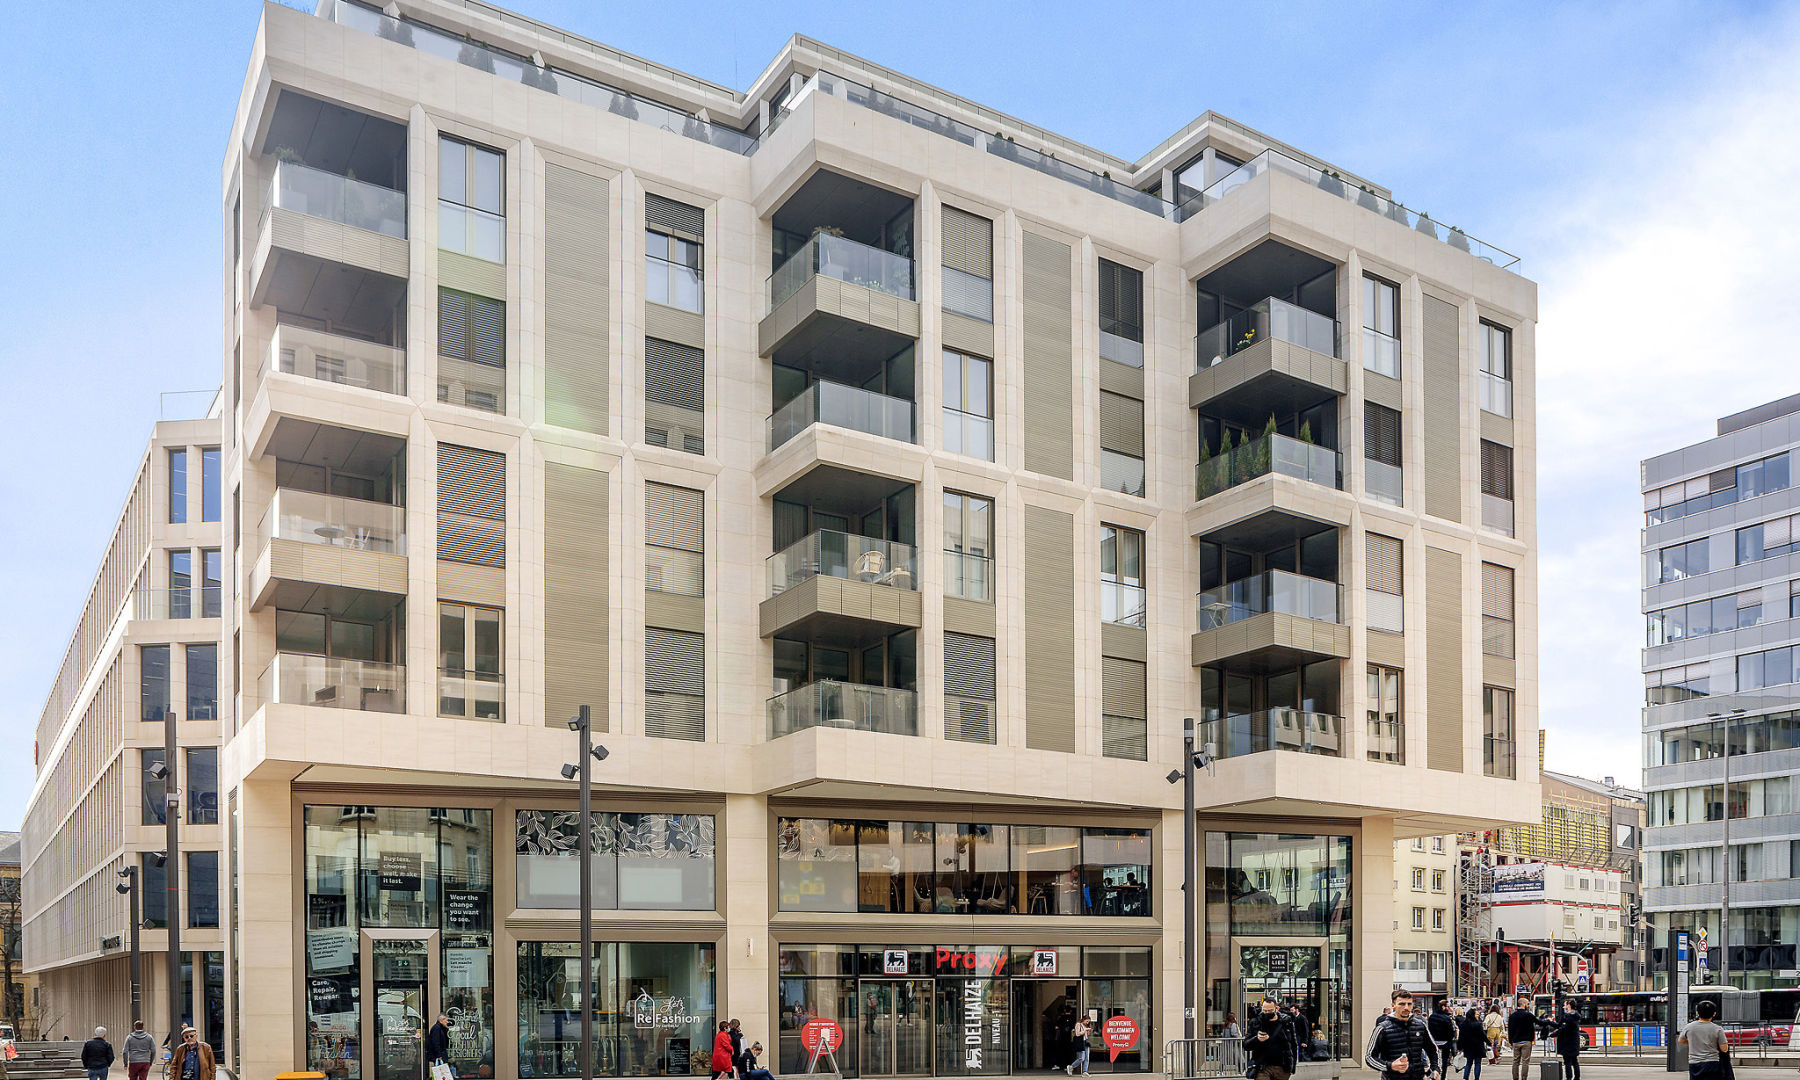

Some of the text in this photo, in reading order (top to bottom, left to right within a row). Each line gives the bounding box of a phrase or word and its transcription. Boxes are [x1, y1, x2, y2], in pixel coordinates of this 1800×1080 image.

[383, 855, 395, 863] Buy
[936, 947, 1008, 976] Proxy
[964, 979, 982, 1045] DELHAIZE
[992, 1018, 1001, 1044] NIVEAU
